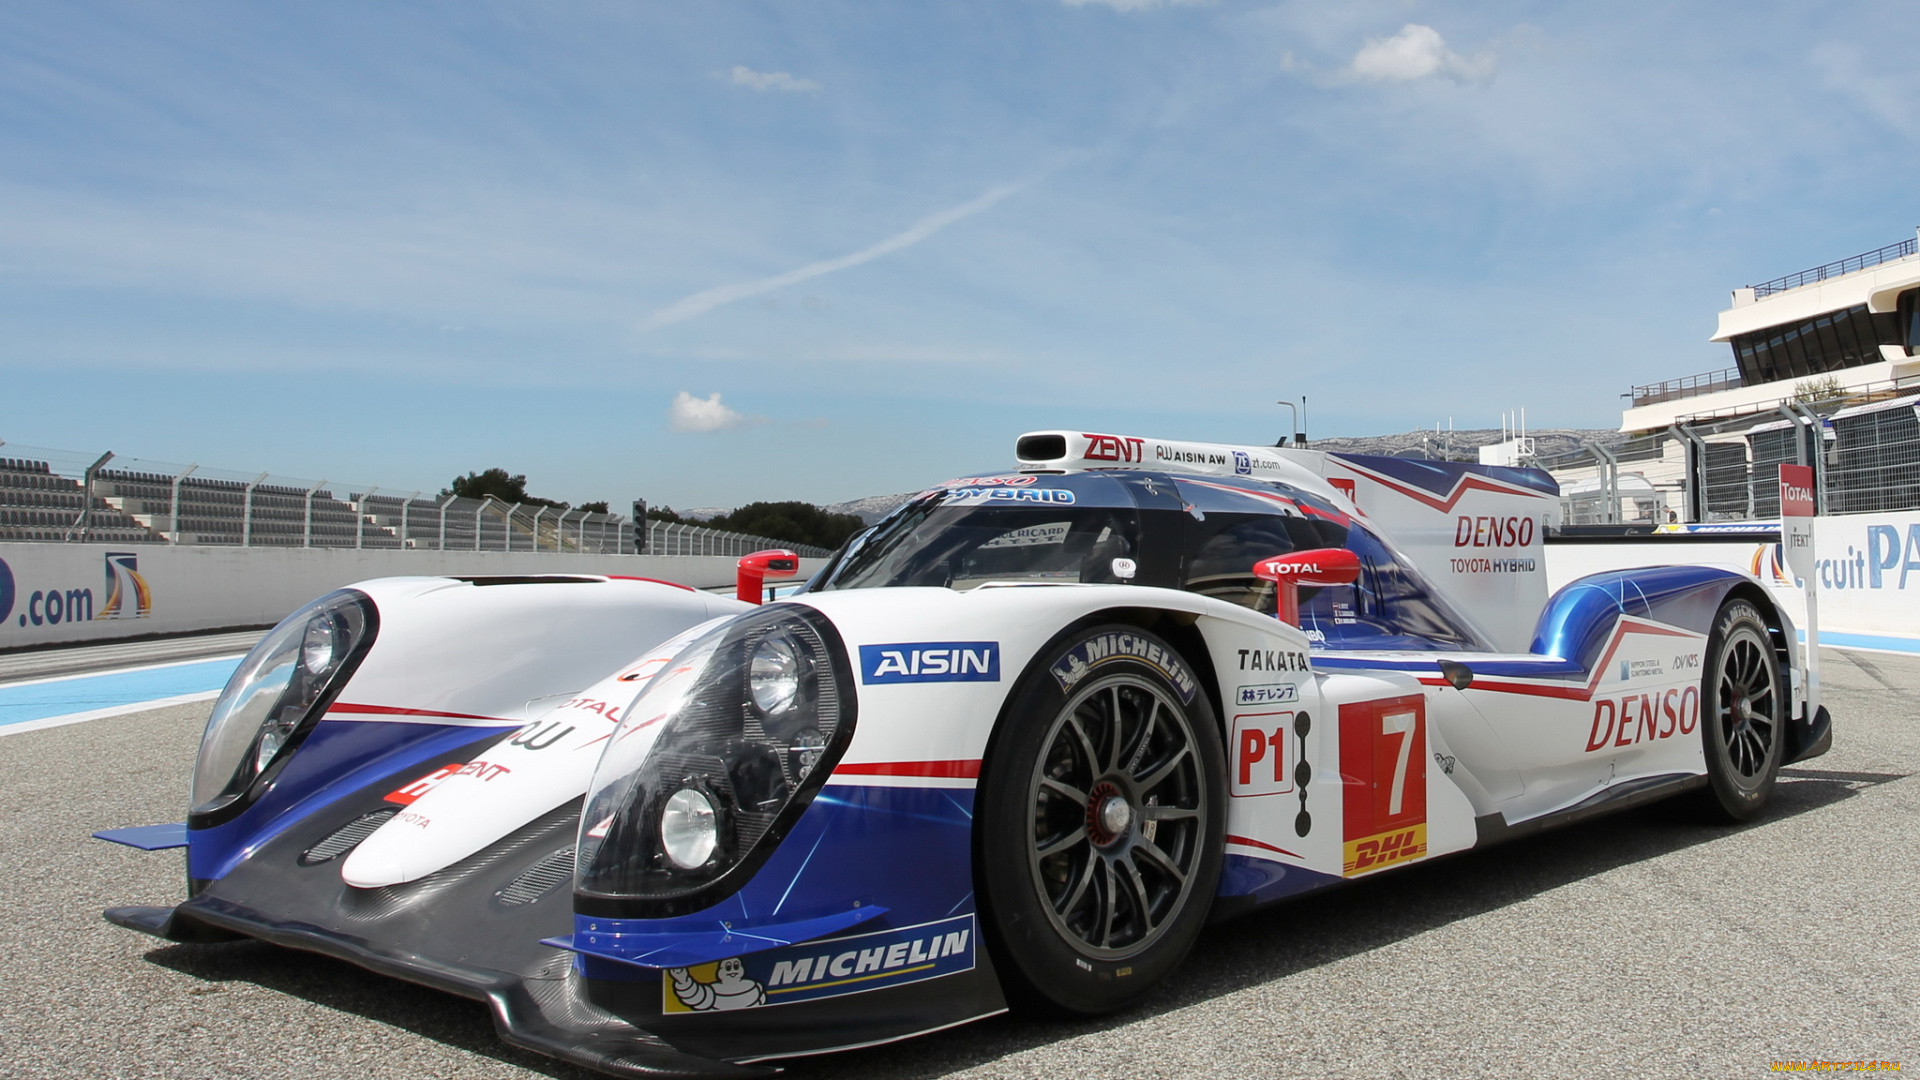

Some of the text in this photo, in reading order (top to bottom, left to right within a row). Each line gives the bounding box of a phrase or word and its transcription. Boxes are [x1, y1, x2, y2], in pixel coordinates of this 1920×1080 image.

[1082, 434, 1145, 463] ZENT
[1174, 451, 1206, 464] AISIN
[1209, 455, 1226, 465] AW
[1252, 456, 1281, 470] zf.com
[940, 488, 1075, 504] HYBRID
[1781, 482, 1814, 501] TOTAL
[1019, 527, 1065, 537] RICARD
[1455, 516, 1534, 547] DENSO
[1265, 562, 1323, 575] TOTAL
[1450, 558, 1536, 573] TOYOTA HYBRID
[873, 649, 990, 677] AISIN
[1085, 634, 1194, 693] MICHELIN
[1238, 649, 1309, 671] TAKATA
[1585, 685, 1699, 752] DENSO
[1239, 727, 1284, 785] P1
[1382, 712, 1416, 816] 7
[1353, 831, 1419, 870] DHL
[768, 929, 969, 986] MICHELIN
